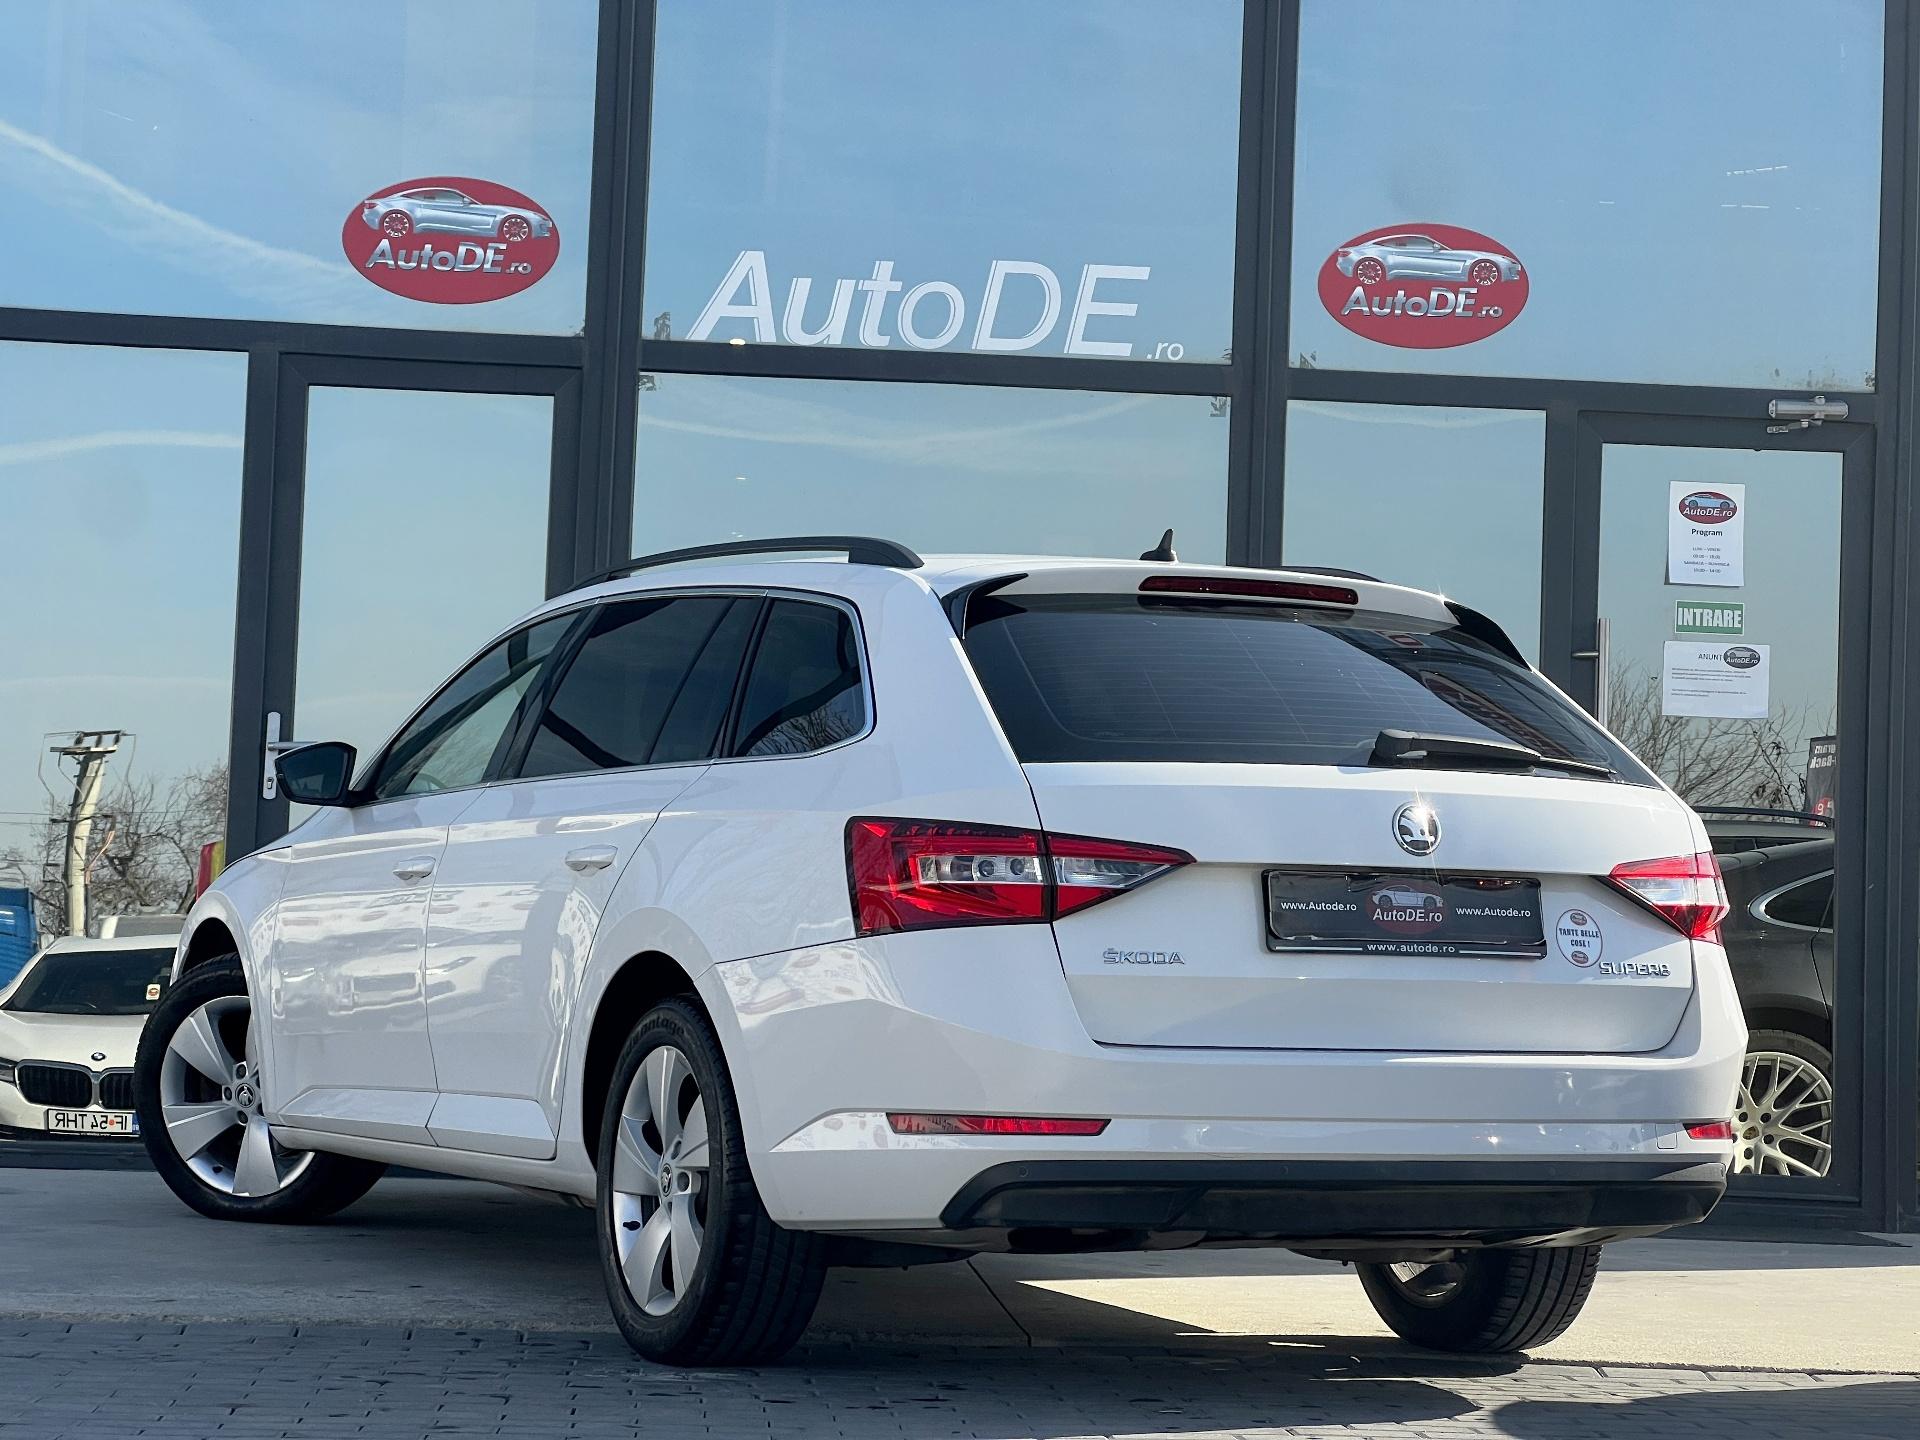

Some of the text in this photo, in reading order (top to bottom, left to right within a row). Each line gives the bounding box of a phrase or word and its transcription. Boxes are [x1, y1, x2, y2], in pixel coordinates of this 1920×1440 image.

[1683, 508, 1733, 517] AutoDE.ro
[1691, 528, 1723, 537] Program
[1677, 607, 1742, 628] INTRARE
[1281, 901, 1357, 912] www.Autode.ro
[1455, 905, 1531, 917] www.Autode.ro
[1373, 908, 1443, 923] AutoDE.ro
[1559, 928, 1599, 938] TANTE BELLE
[1367, 943, 1456, 953] www.autode.ro
[1571, 939, 1586, 947] COSE
[1103, 947, 1185, 965] ŠKODA
[1599, 961, 1671, 977] SUPERB
